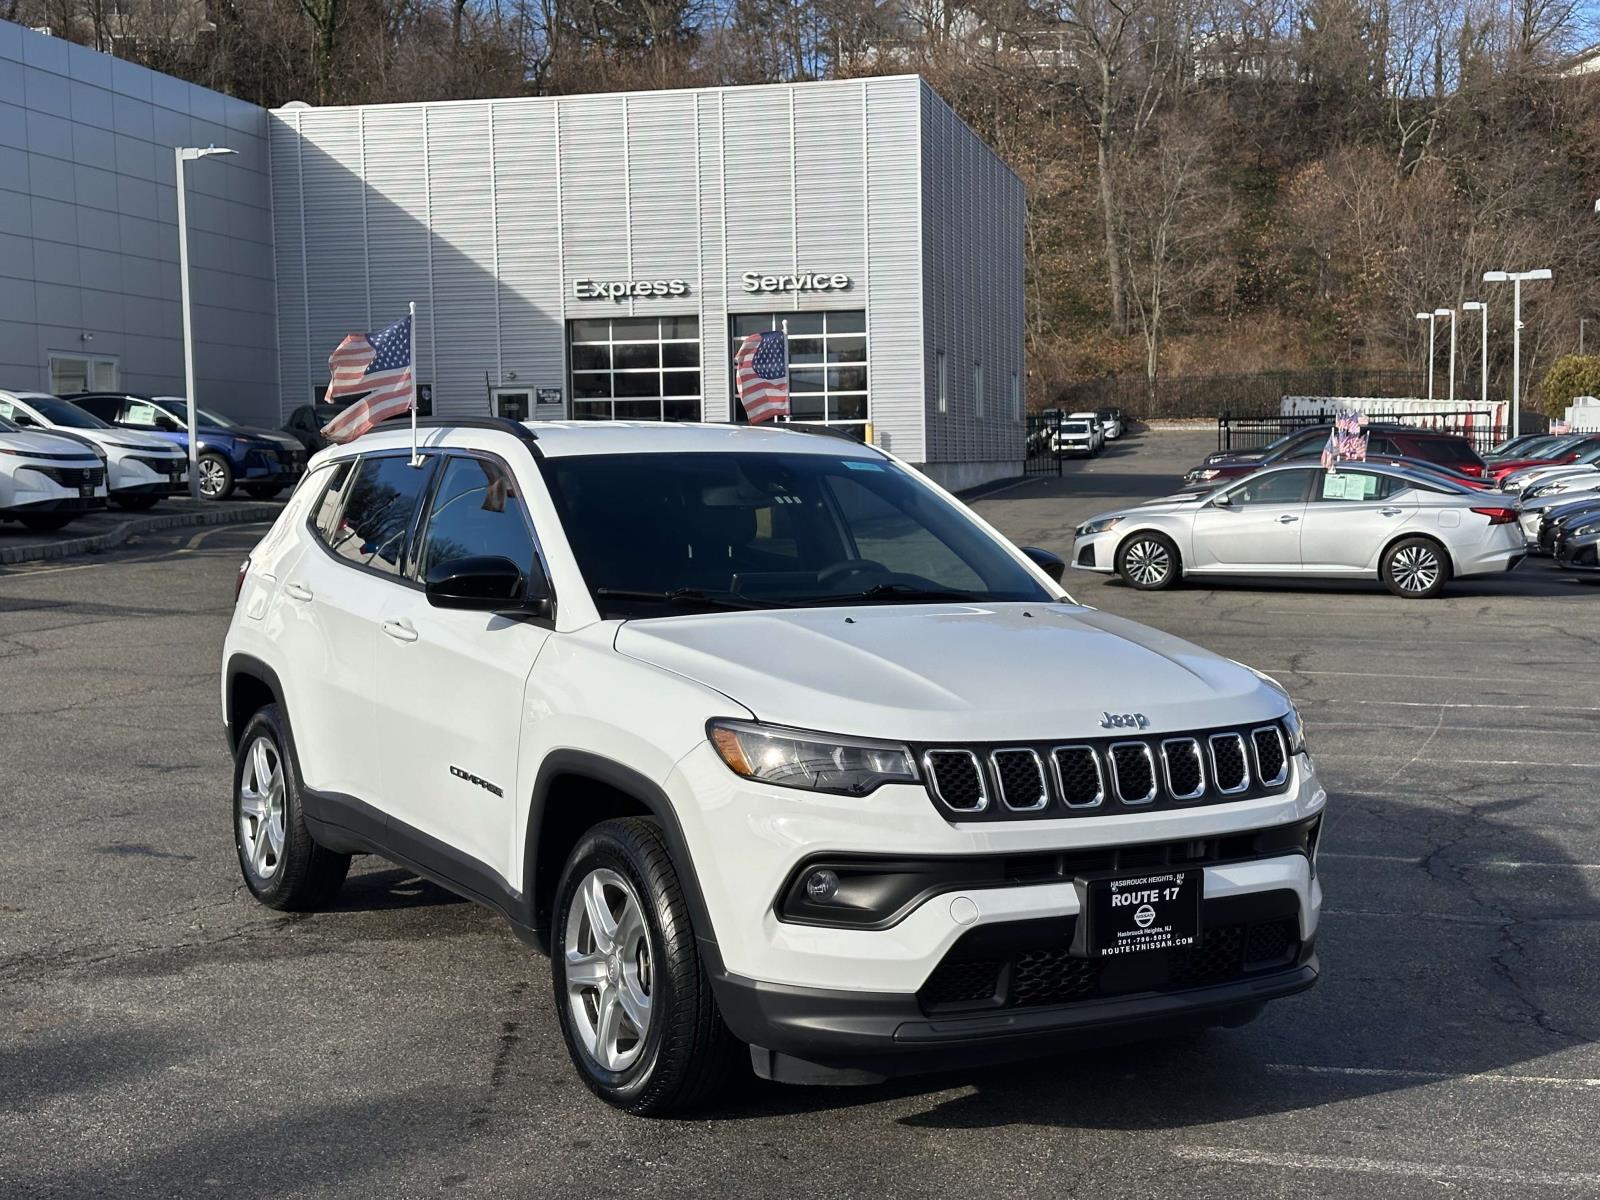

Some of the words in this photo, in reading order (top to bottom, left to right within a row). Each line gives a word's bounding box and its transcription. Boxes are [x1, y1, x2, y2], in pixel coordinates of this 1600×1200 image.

[571, 277, 686, 301] Express
[741, 270, 849, 292] Service
[1098, 712, 1148, 730] Jeep
[449, 765, 504, 798] COMPASS
[1110, 878, 1147, 888] HASBROUCK
[1112, 890, 1159, 906] ROUTE
[1163, 887, 1180, 901] 17
[1117, 929, 1143, 938] Hasbrouck
[1101, 936, 1193, 955] ROUTE17NISSAN.COM
